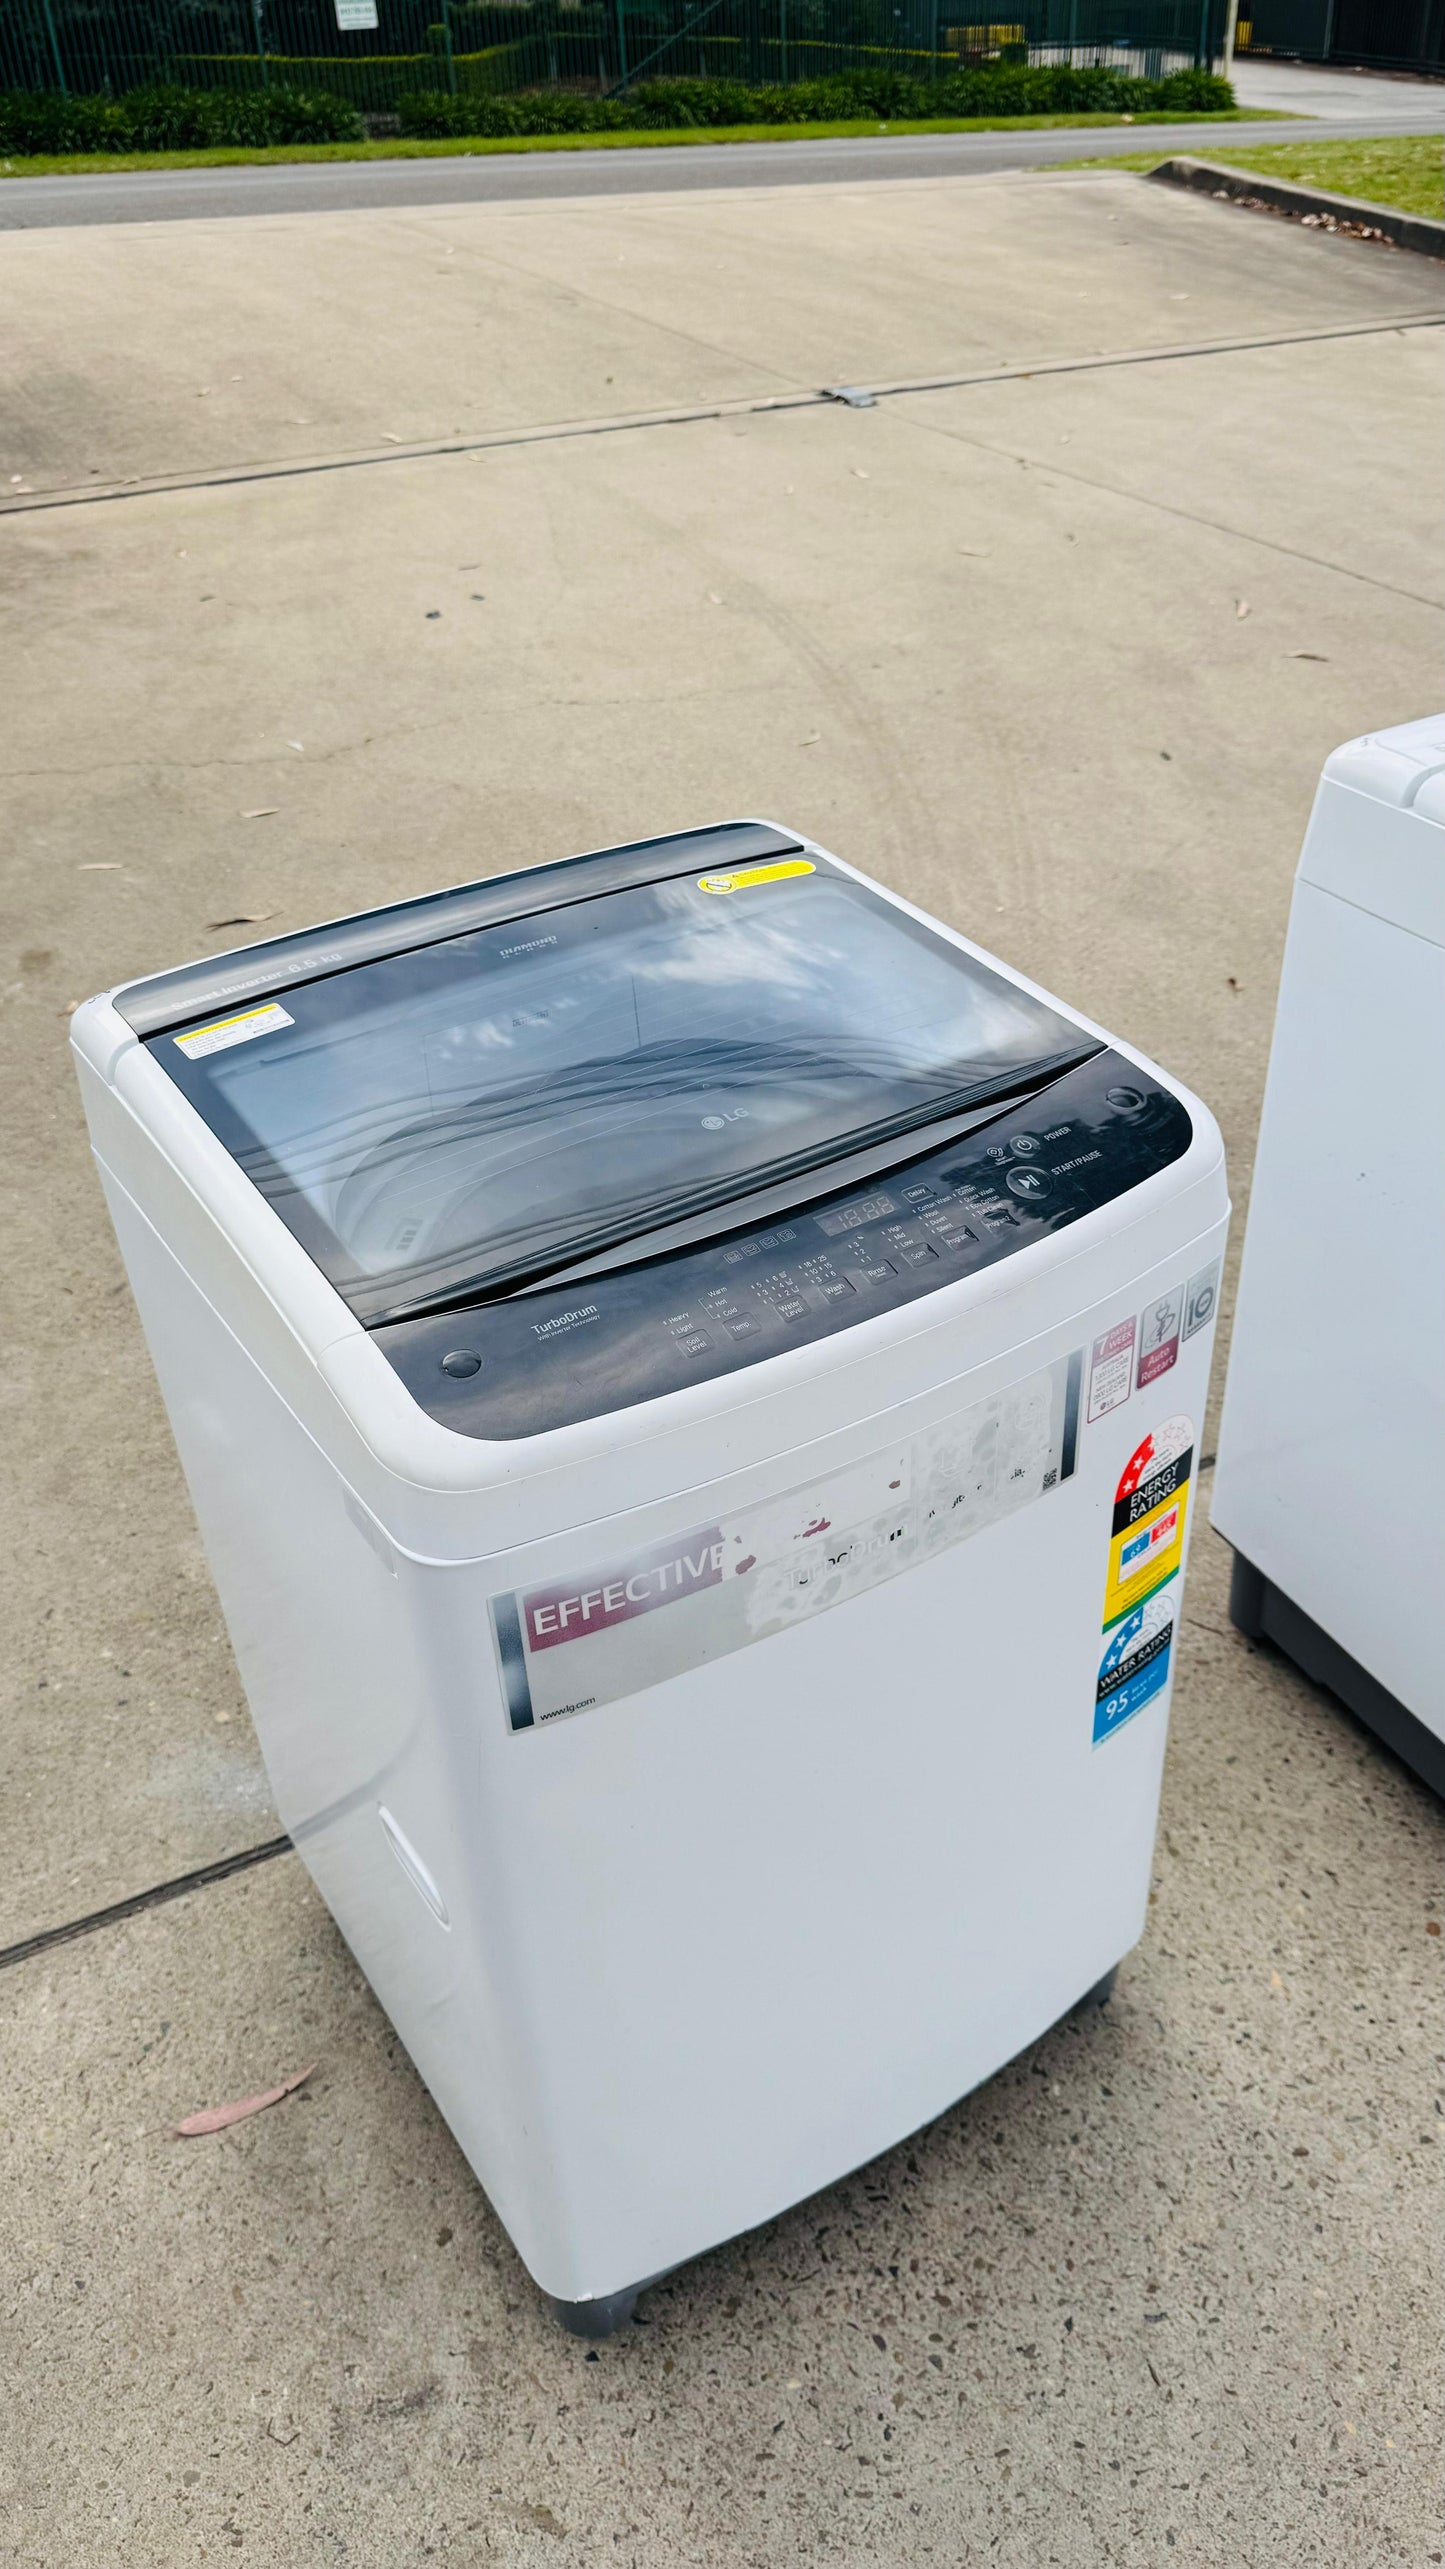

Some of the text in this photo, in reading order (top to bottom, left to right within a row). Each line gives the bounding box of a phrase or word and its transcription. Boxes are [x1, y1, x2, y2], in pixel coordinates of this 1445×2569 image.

[500, 935, 557, 956] DIAMOND
[171, 952, 343, 1012] Smart Inverter 6.5 kg
[722, 1108, 749, 1122] LG
[1043, 1126, 1072, 1142] POWER
[1051, 1150, 1103, 1176] START/PAUSE
[908, 1187, 926, 1198] Delay
[964, 1194, 979, 1203] Quick
[979, 1187, 996, 1197] Wash
[918, 1195, 953, 1212] Cotton Wash
[970, 1195, 1000, 1209] Eco Cotton
[923, 1210, 939, 1220] Wool
[977, 1202, 1004, 1216] Tub Clean
[930, 1216, 947, 1226] Duvet
[888, 1224, 903, 1234] High
[936, 1223, 954, 1233] Silent
[894, 1232, 906, 1240] Mid
[900, 1239, 914, 1248] Low
[817, 1254, 827, 1263] 25
[911, 1250, 926, 1260] Spin
[823, 1262, 833, 1270] 15
[867, 1265, 887, 1278] Rinse
[707, 1286, 728, 1298] Warm
[825, 1283, 846, 1296] Wash
[714, 1299, 728, 1308] Hot
[778, 1300, 800, 1313] Water
[668, 1312, 689, 1324] Heavy
[722, 1307, 738, 1317] Cold
[785, 1306, 804, 1318] Level
[531, 1304, 598, 1334] TurboDrum
[676, 1323, 693, 1334] Light
[731, 1321, 752, 1333] Temp.
[686, 1336, 701, 1347] Soil
[687, 1340, 707, 1353] Level
[1096, 1335, 1110, 1356] 7
[1109, 1331, 1133, 1350] WEEK
[1147, 1348, 1170, 1368] Auto
[1140, 1355, 1174, 1383] Restart
[1130, 1461, 1180, 1508] ENERGY
[1129, 1478, 1177, 1522] RATING
[533, 1541, 725, 1636] EFFECTIVE
[1099, 1658, 1136, 1689] WATER
[1137, 1625, 1173, 1661] RATING
[539, 1697, 596, 1721] www.lg.com
[1105, 1690, 1129, 1721] 95
